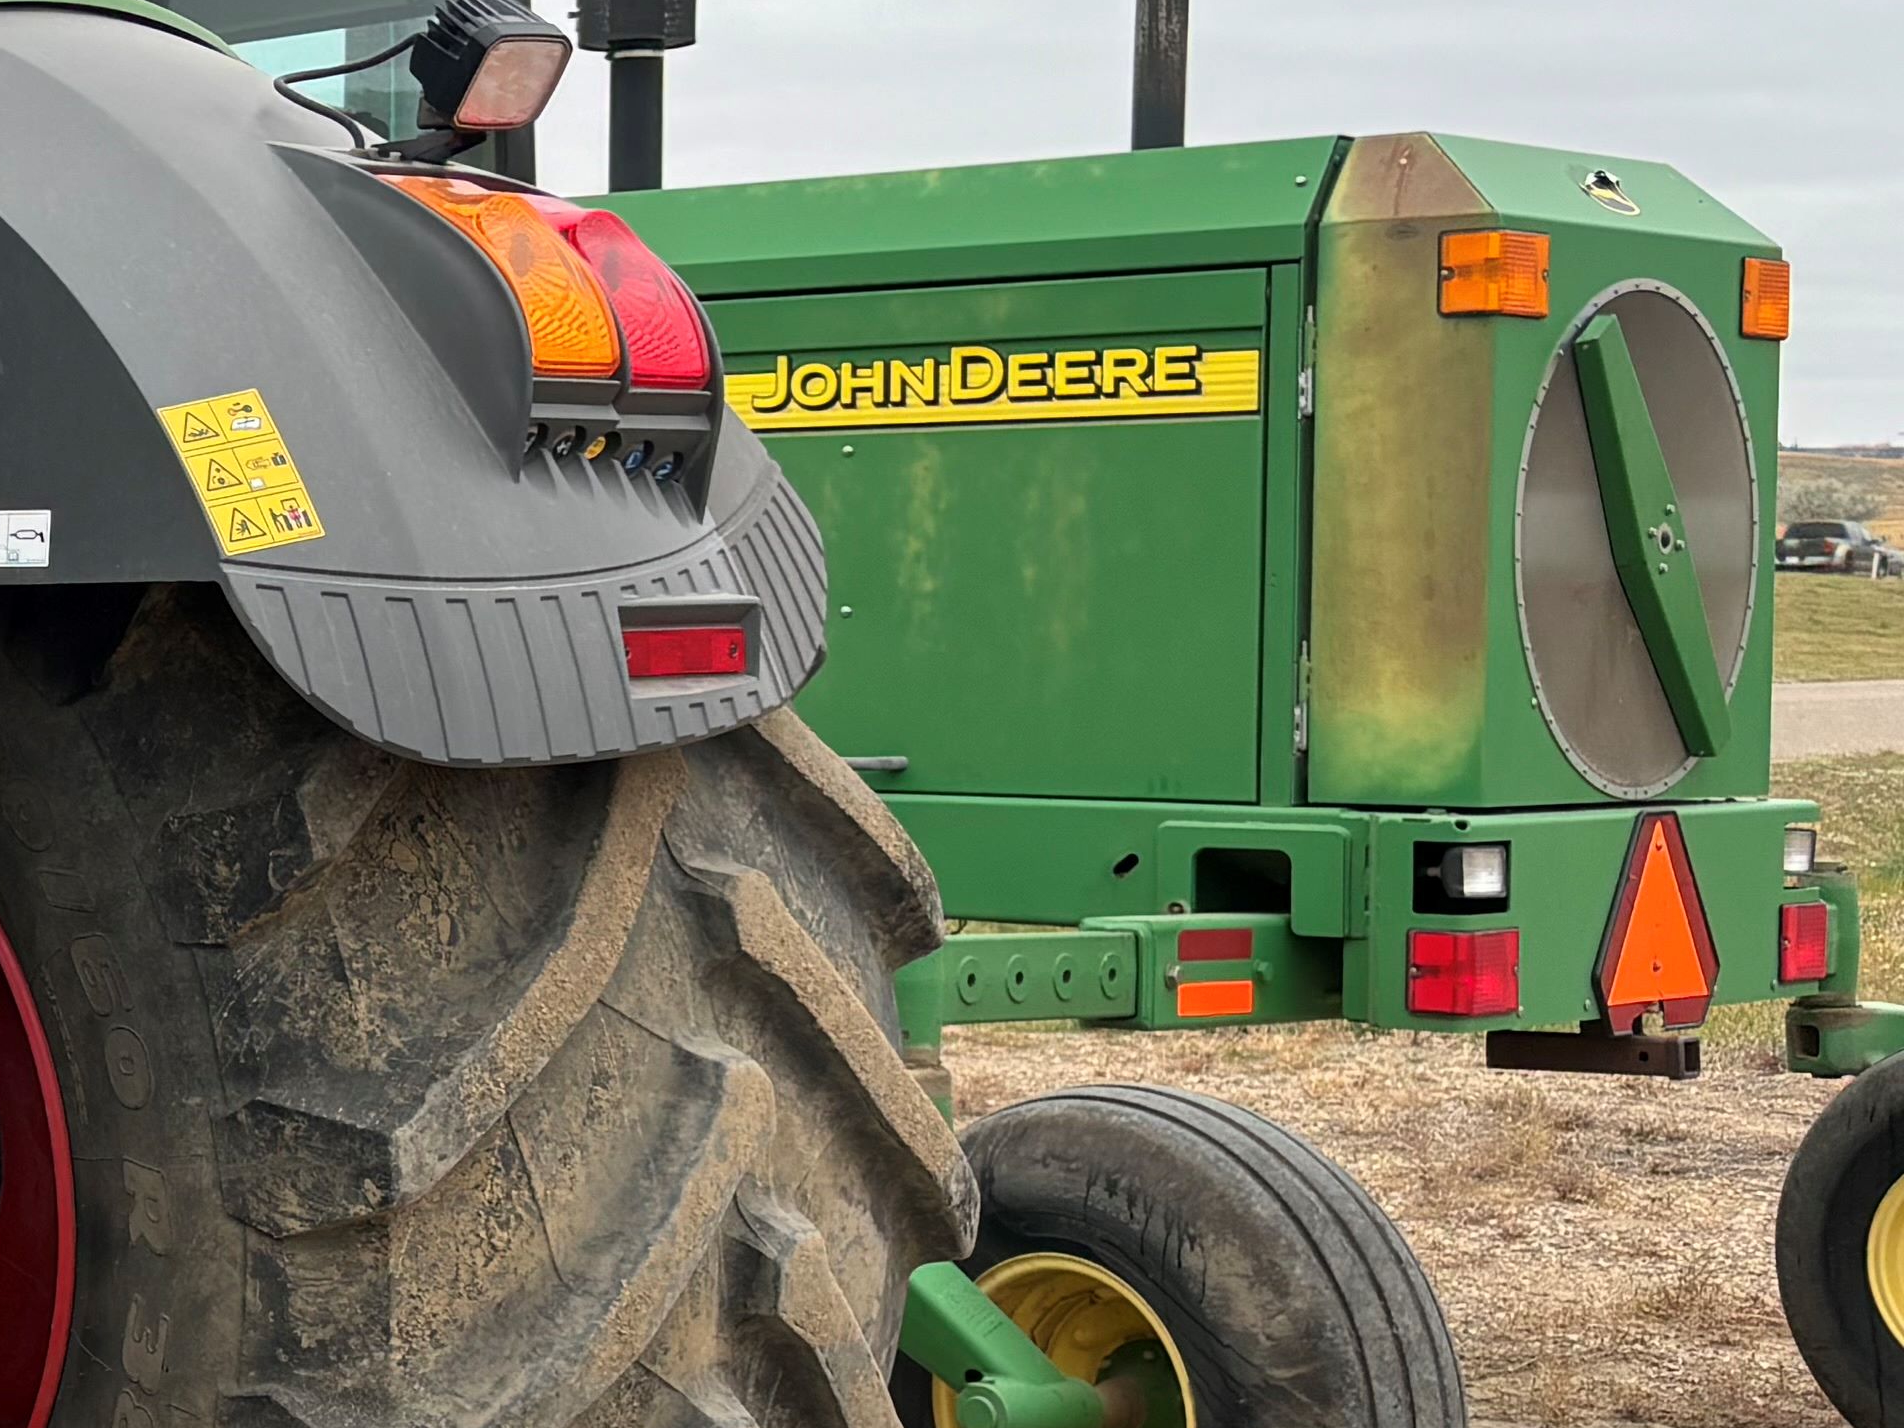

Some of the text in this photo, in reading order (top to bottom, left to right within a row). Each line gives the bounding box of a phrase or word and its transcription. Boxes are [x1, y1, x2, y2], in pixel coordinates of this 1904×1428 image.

[751, 345, 1201, 411] JOHN DEERE
[122, 1156, 174, 1262] R
